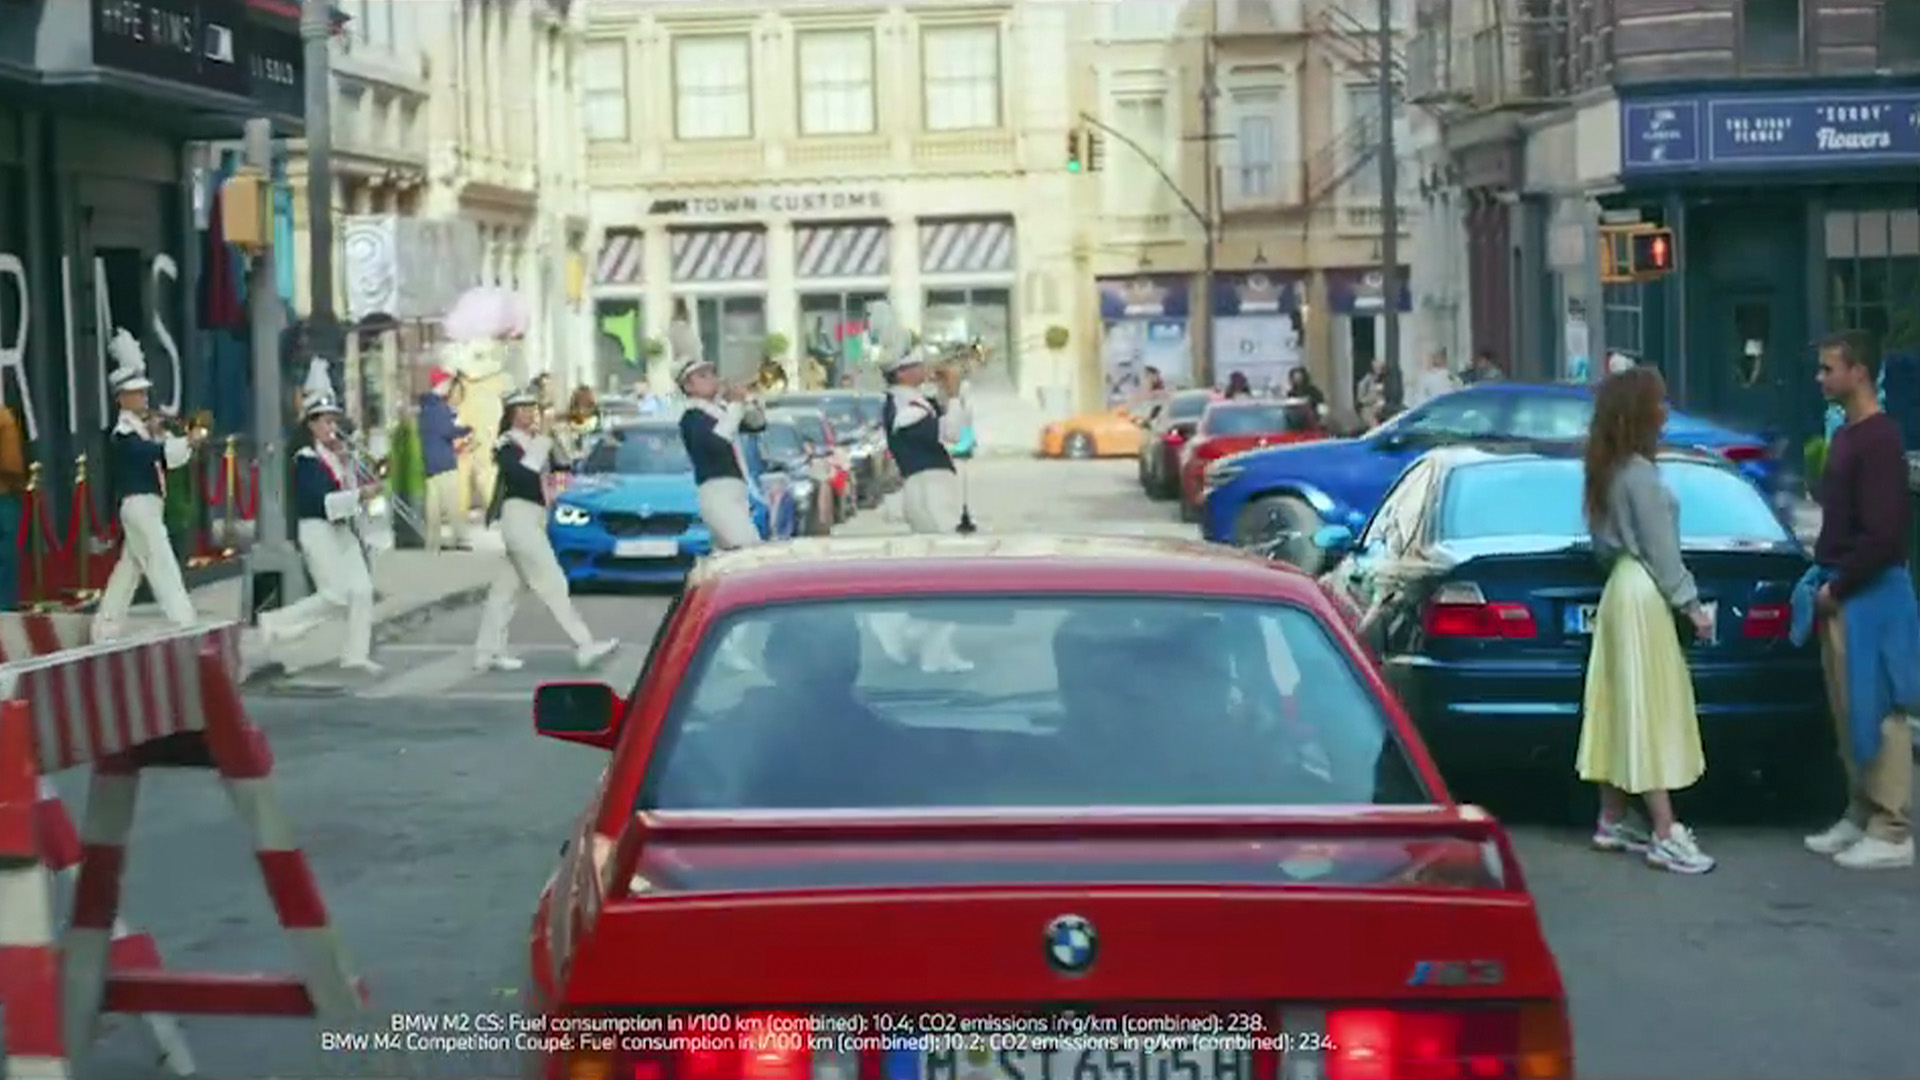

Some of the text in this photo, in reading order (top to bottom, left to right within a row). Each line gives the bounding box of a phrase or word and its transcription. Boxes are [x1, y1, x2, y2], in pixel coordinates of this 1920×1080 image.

[1816, 127, 1891, 152] Flowers
[693, 197, 757, 213] TOWN
[770, 190, 882, 212] CUSTOMS
